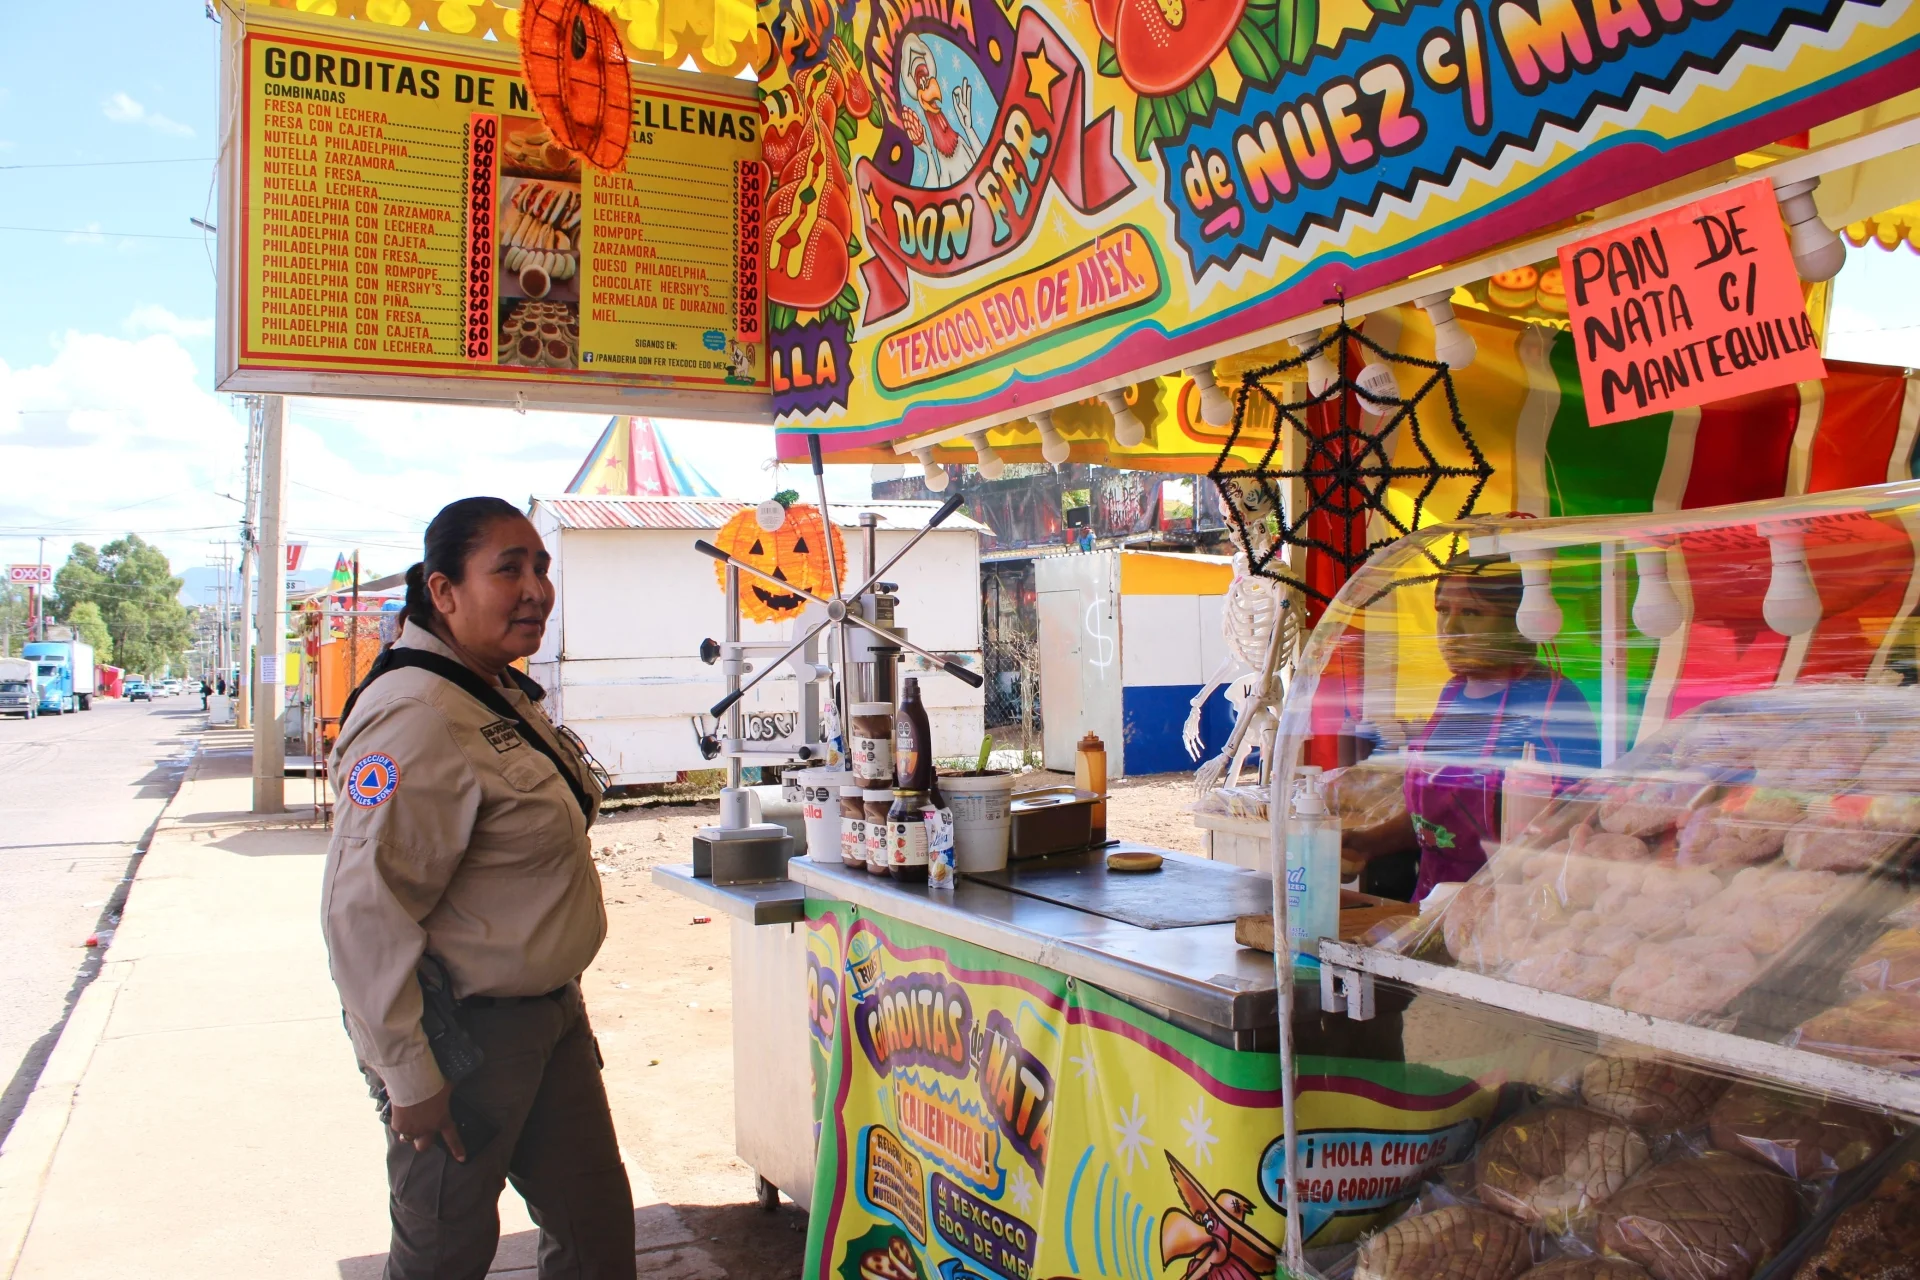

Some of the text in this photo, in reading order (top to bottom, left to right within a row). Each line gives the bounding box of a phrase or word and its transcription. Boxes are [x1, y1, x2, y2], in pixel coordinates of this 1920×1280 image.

[264, 82, 346, 104] COMBINADAS
[264, 47, 440, 99] GORDITAS
[454, 73, 495, 107] DE
[631, 99, 756, 143] ELLENAS
[264, 98, 303, 113] FRESA
[306, 103, 332, 117] CON
[335, 107, 389, 124] LECHERA
[264, 113, 303, 128] FRESA
[309, 118, 333, 133] CON
[338, 121, 384, 138] CAJETA
[1183, 148, 1235, 211] de
[1236, 62, 1421, 206] NUEZ
[263, 130, 318, 145] NUTELLA
[324, 135, 408, 156] PHILADELPHIA
[263, 146, 318, 161] NUTELLA
[325, 151, 395, 169] ZARZAMORA
[263, 161, 317, 176] NUTELLA
[324, 166, 362, 181] FRESA
[593, 174, 634, 191] CAJETA
[263, 177, 317, 192] NUTELLA
[325, 182, 378, 198] LECHERA
[892, 108, 1050, 264] DON FER
[264, 192, 350, 210] PHILADELPHIA
[355, 199, 379, 214] CON
[383, 203, 451, 221] ZARZAMORA
[593, 191, 639, 208] NUTELLA
[263, 208, 350, 225] PHILADELPHIA
[355, 215, 379, 230] CON
[384, 219, 435, 234] LECHERA
[594, 208, 641, 224] LECHERA
[263, 223, 349, 241] PHILADELPHIA
[354, 229, 378, 244] CON
[383, 233, 427, 248] CAJETA
[593, 224, 643, 241] ROMPOPE
[263, 239, 349, 255] PHILADELPHIA
[353, 245, 378, 259] CON
[382, 248, 419, 263] FRESA
[593, 241, 656, 258] ZARZAMORA
[1571, 205, 1759, 306] PAN DE
[263, 254, 349, 271] PHILADELPHIA
[355, 261, 379, 275] CON
[384, 264, 438, 279] ROMPOPE
[592, 257, 627, 272] QUESO
[635, 262, 706, 280] PHILADELPHIA
[262, 270, 349, 286] PHILADELPHIA
[355, 276, 379, 290] CON
[385, 279, 442, 295] HERSHY'S
[592, 275, 651, 291] CHOCOLATE
[660, 281, 710, 297] HERSHY'S
[262, 286, 348, 301] PHILADELPHIA
[353, 291, 377, 305] CON
[382, 292, 410, 307] PIÑA
[592, 292, 657, 308] MERMELADA
[663, 297, 675, 310] DE
[680, 298, 725, 315] DURAZNO
[1035, 268, 1071, 325] DE
[262, 301, 348, 317] PHILADELPHIA
[355, 307, 379, 320] CON
[385, 309, 422, 323] FRESA
[592, 309, 616, 322] MIEL
[1583, 283, 1694, 362] NATA
[262, 317, 348, 332] PHILADELPHIA
[355, 322, 379, 336] CON
[385, 325, 430, 339] CAJETA
[262, 333, 348, 348] PHILADELPHIA
[353, 337, 377, 351] CON
[383, 340, 433, 354] LECHERA
[635, 339, 665, 350] SIGANOS
[638, 356, 652, 365] DON
[654, 357, 667, 366] FER
[668, 358, 697, 368] TEXCOCO
[699, 360, 712, 369] EDO
[1601, 311, 1819, 415] MANTEQUILLA
[11, 568, 51, 580] OXXO
[350, 754, 397, 784] PROTECCION CIVIL
[868, 987, 964, 1063] GORDITAS
[1321, 1141, 1373, 1169] HOLA
[1381, 1136, 1448, 1166] CHICAS
[1274, 1176, 1334, 1205] TNGO
[951, 1190, 1028, 1250] TEXCOCO
[938, 1209, 970, 1246] EDO.
[973, 1233, 993, 1260] DE
